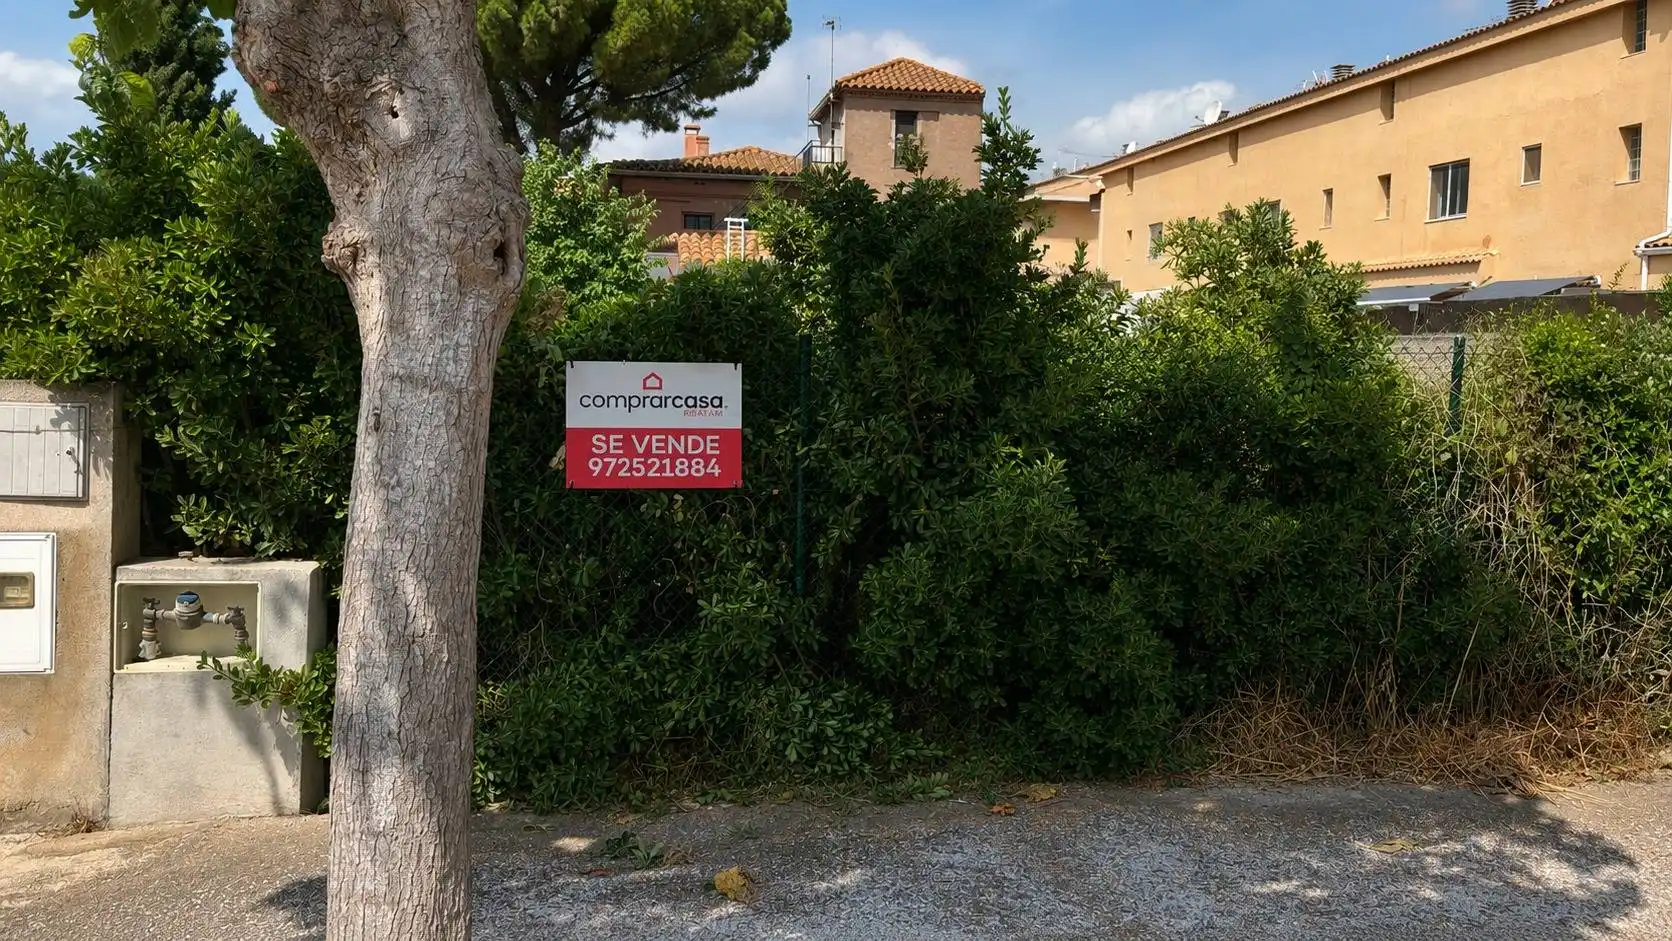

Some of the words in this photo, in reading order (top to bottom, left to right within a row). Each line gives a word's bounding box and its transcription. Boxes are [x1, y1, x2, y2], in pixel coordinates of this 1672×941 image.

[591, 434, 624, 455] SE
[631, 434, 720, 455] VENDE
[588, 457, 721, 477] 972521884
